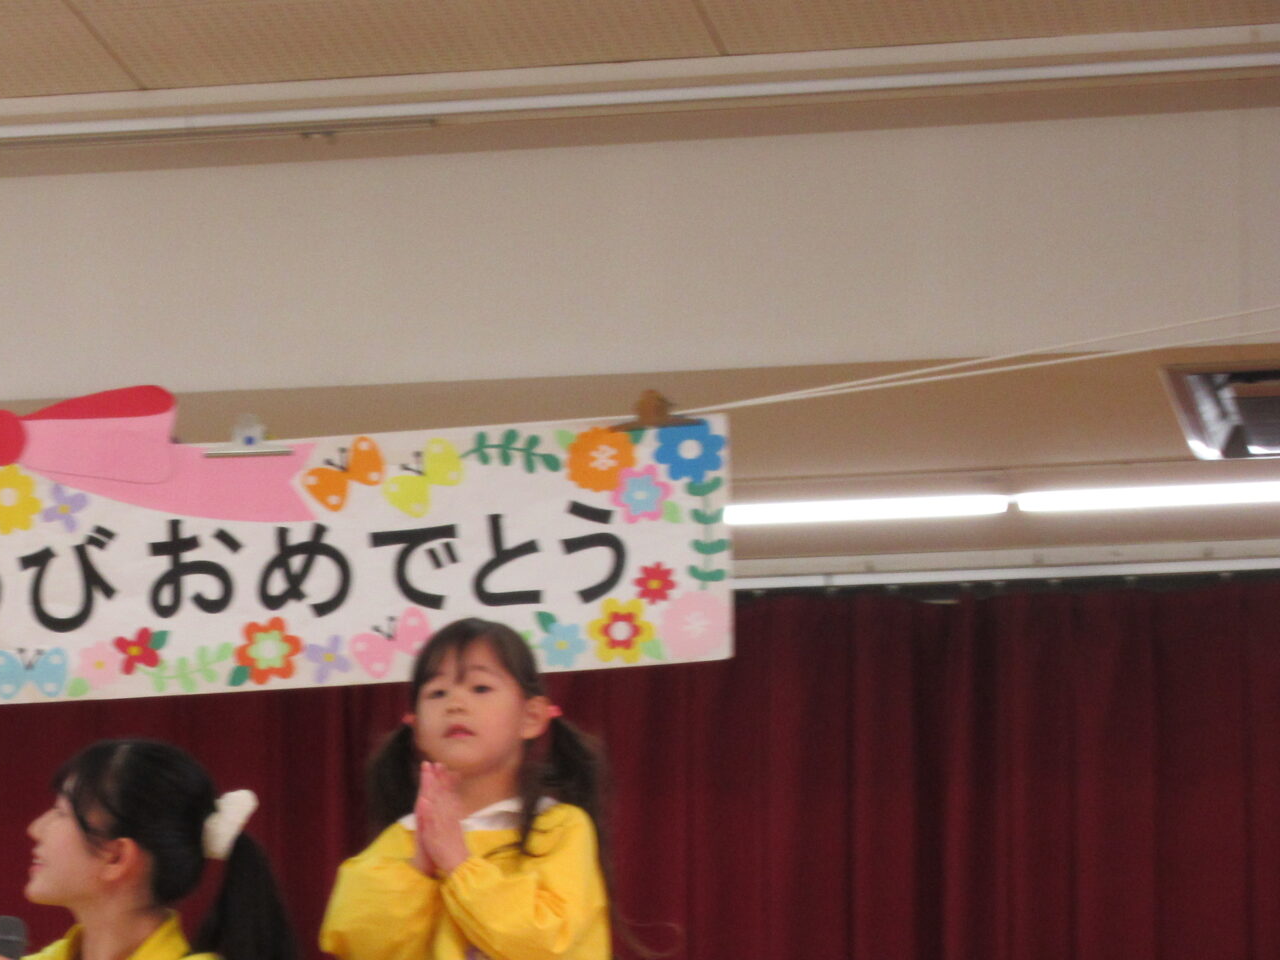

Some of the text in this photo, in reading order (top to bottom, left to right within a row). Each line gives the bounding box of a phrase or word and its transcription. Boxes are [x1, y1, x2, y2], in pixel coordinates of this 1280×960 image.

[148, 501, 627, 618] おめでとう
